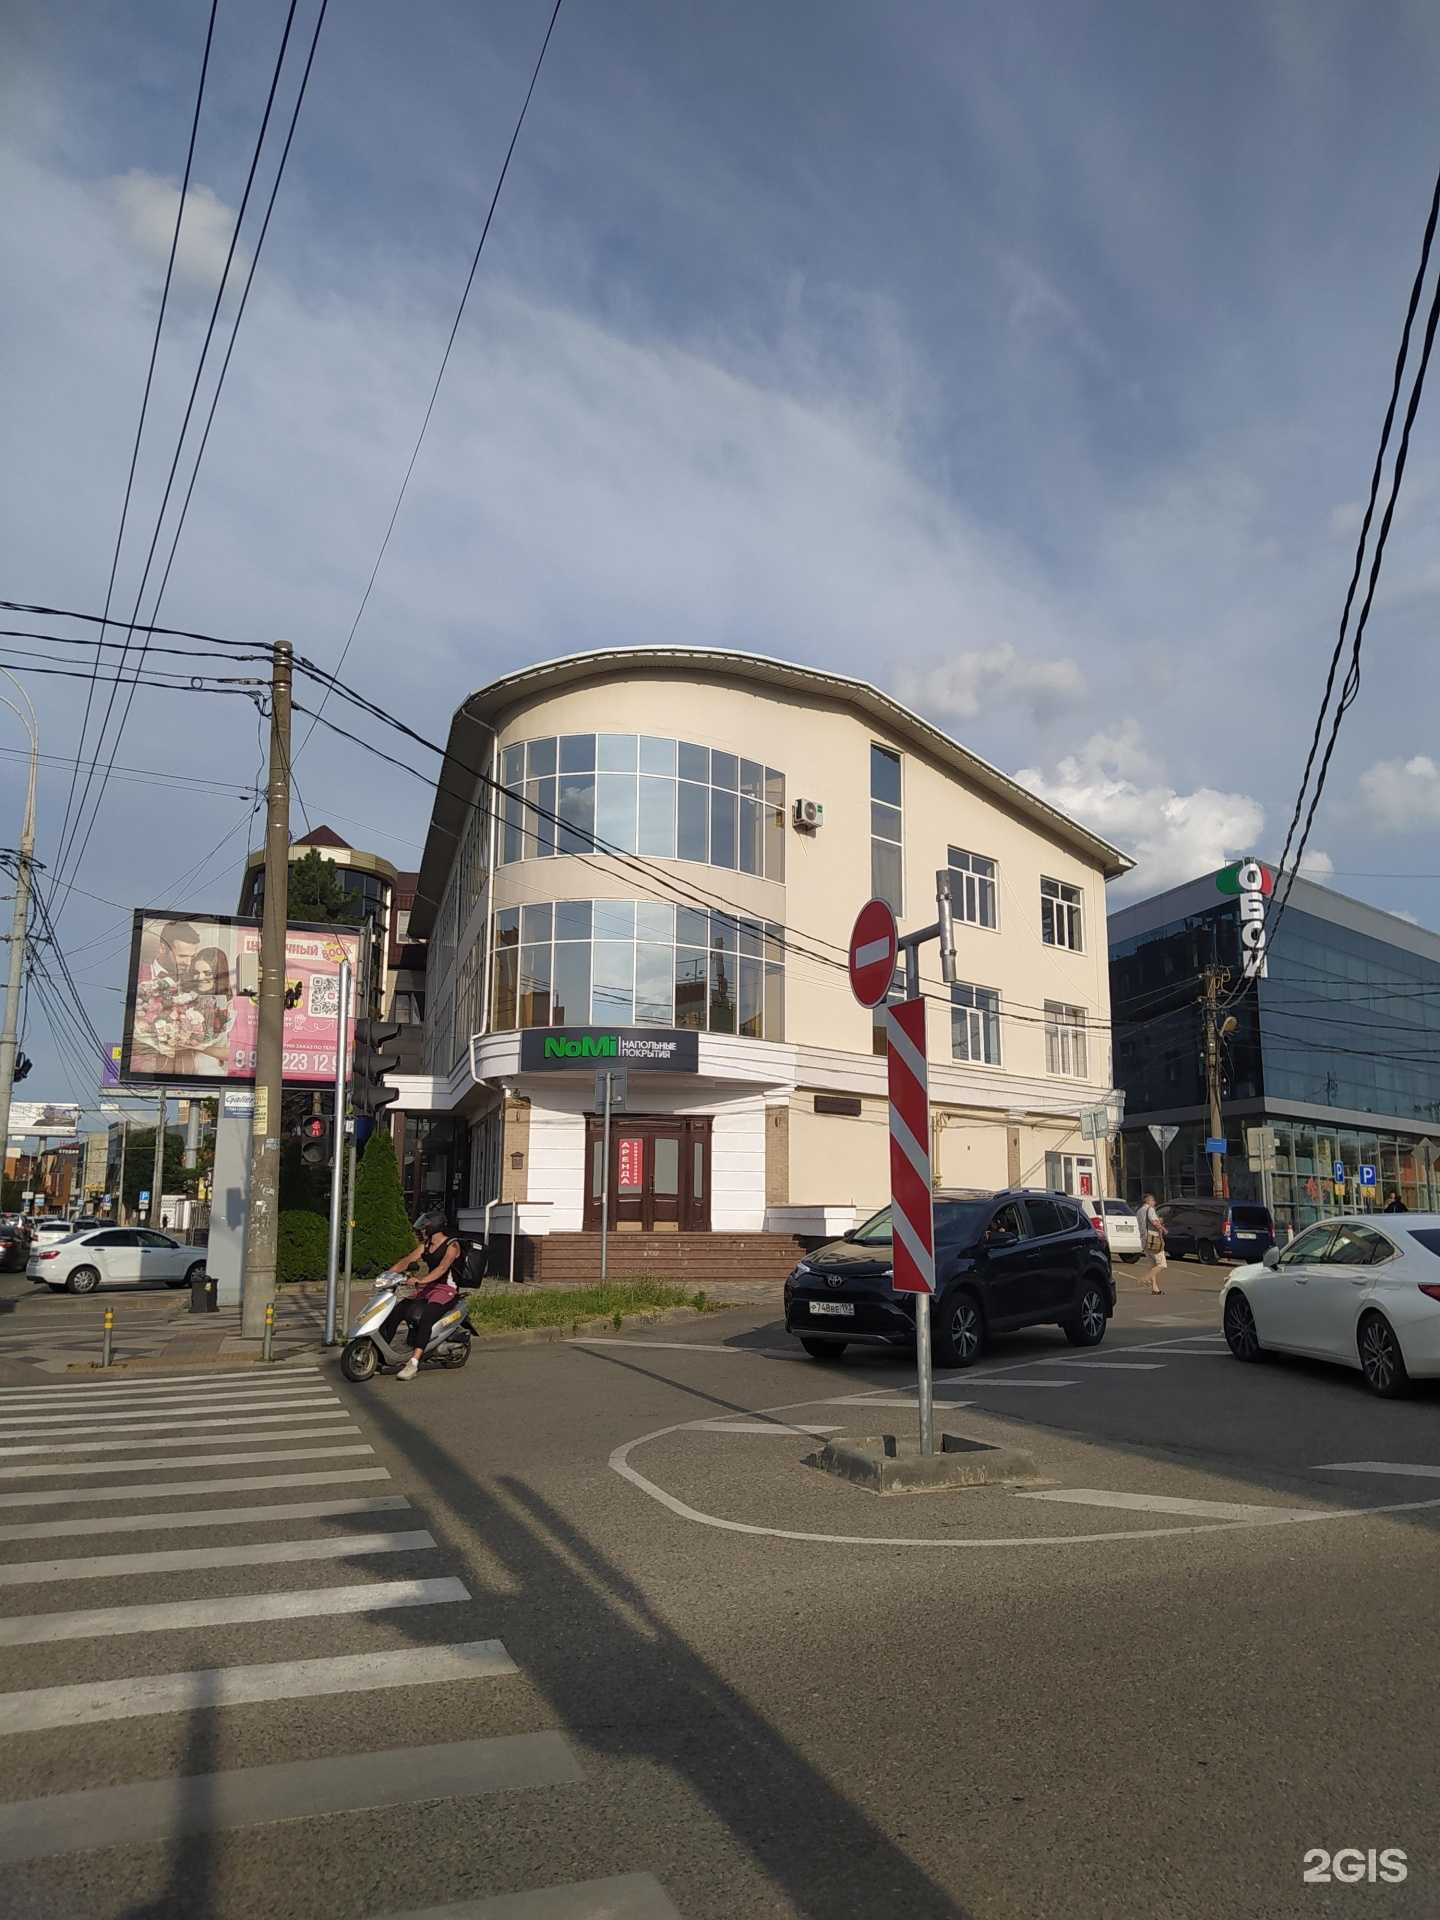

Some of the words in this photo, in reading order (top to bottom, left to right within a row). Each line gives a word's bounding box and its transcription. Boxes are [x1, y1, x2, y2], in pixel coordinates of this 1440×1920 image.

[1238, 862, 1269, 978] ОБОИ
[543, 1035, 618, 1058] NoMi
[622, 1039, 677, 1051] НАПОЛЬНЫЕ
[622, 1048, 671, 1059] ПОКРЫТИЯ
[282, 1052, 308, 1071] 223
[312, 1053, 329, 1072] 12
[620, 1142, 630, 1184] АРЕНДА
